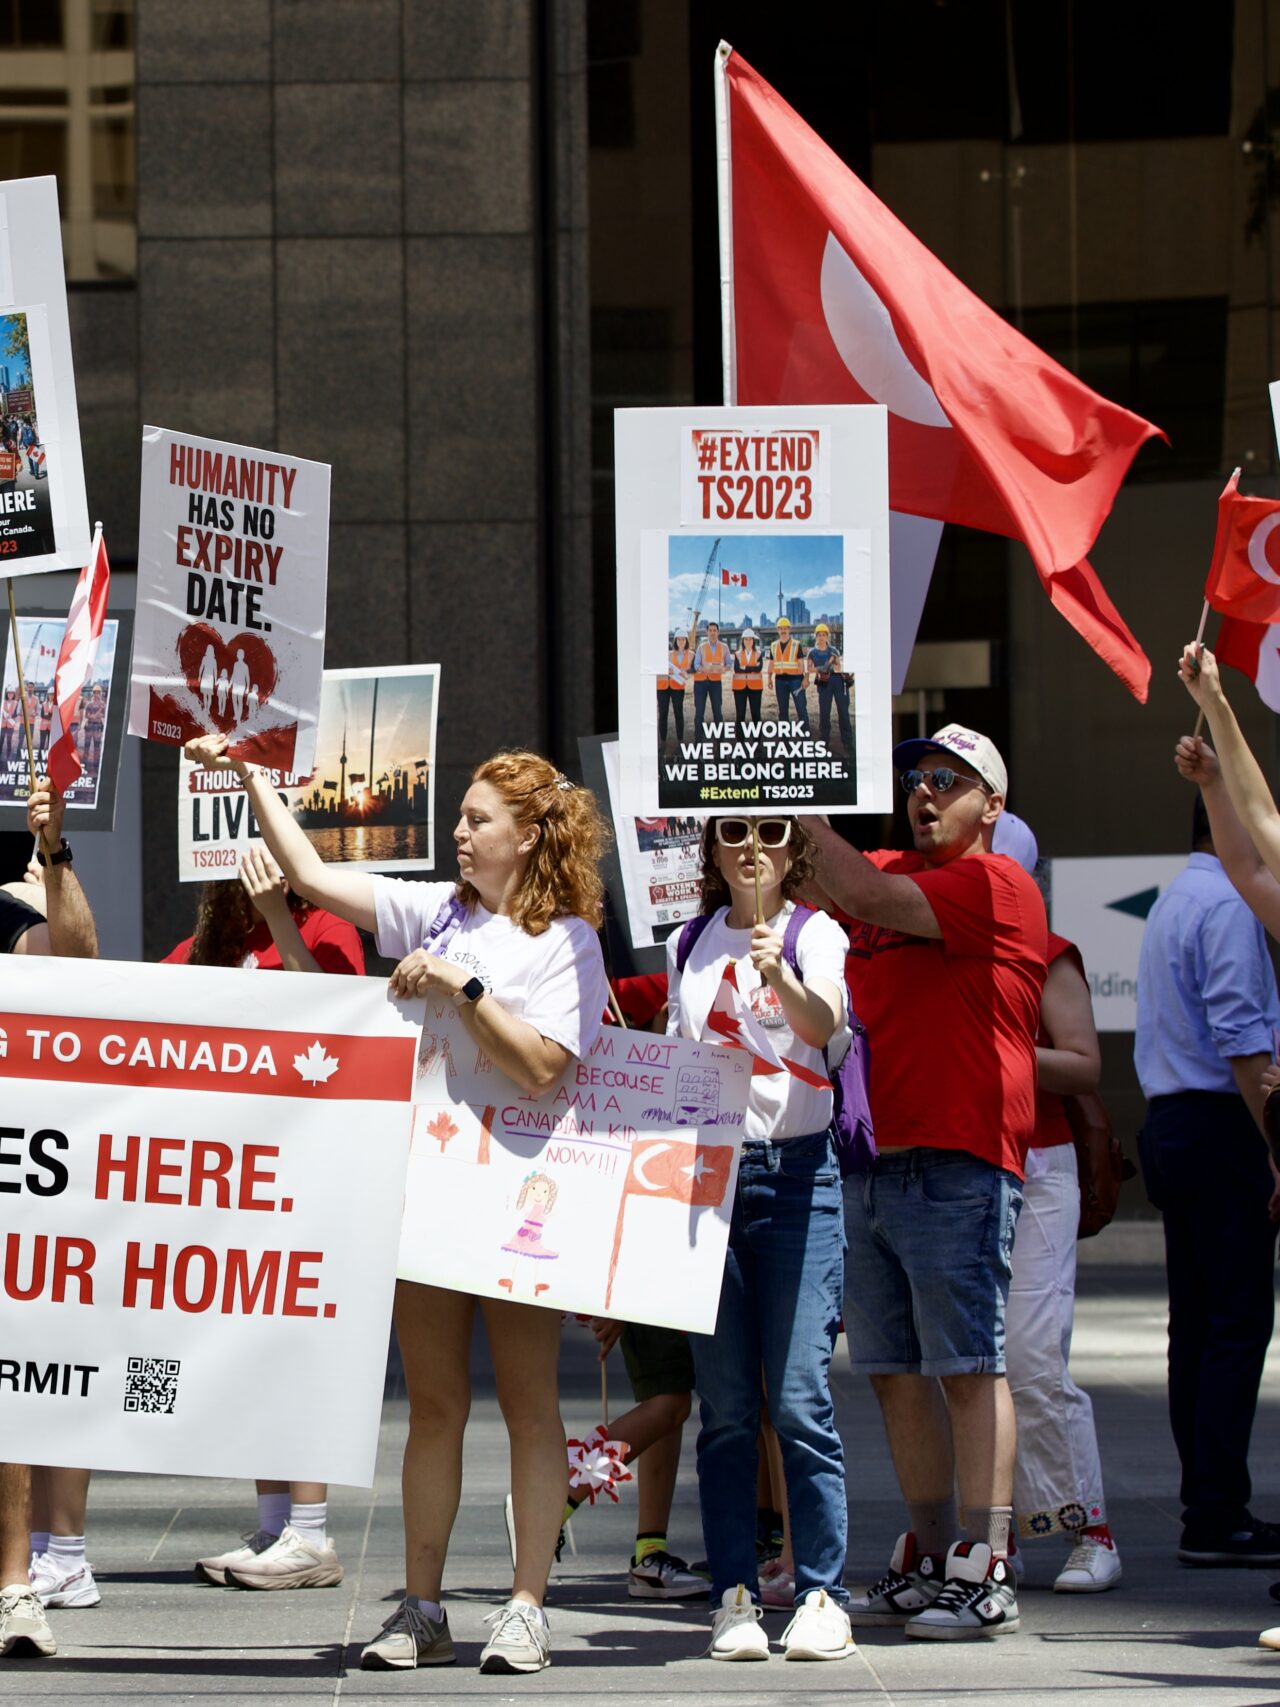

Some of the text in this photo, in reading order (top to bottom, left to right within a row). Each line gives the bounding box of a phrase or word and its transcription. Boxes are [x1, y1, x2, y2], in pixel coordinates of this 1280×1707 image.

[698, 437, 812, 471] #EXTEND
[170, 443, 296, 509] HUMANITY
[698, 475, 812, 520] TS2023
[189, 493, 275, 540] HAS NO
[3, 525, 35, 536] Canada.
[177, 525, 283, 586] EXPIRY
[187, 572, 272, 632] DATE.
[153, 721, 181, 739] TS2023
[702, 721, 810, 738] WE WORK.
[681, 741, 832, 760] WE PAY TAXES.
[7, 761, 25, 773] WE
[665, 762, 848, 781] WE BELONG HERE.
[700, 786, 814, 799] #Extend TS2023
[193, 849, 236, 868] TS2023
[666, 881, 696, 890] EXTEND
[26, 1029, 81, 1063] TO
[99, 1034, 278, 1076] CANADA
[628, 1043, 678, 1066] NOT
[553, 1086, 622, 1112] AM A
[501, 1106, 638, 1142] CANADIAN KID
[94, 1134, 294, 1213] HERE.
[122, 1241, 338, 1320] HOME.
